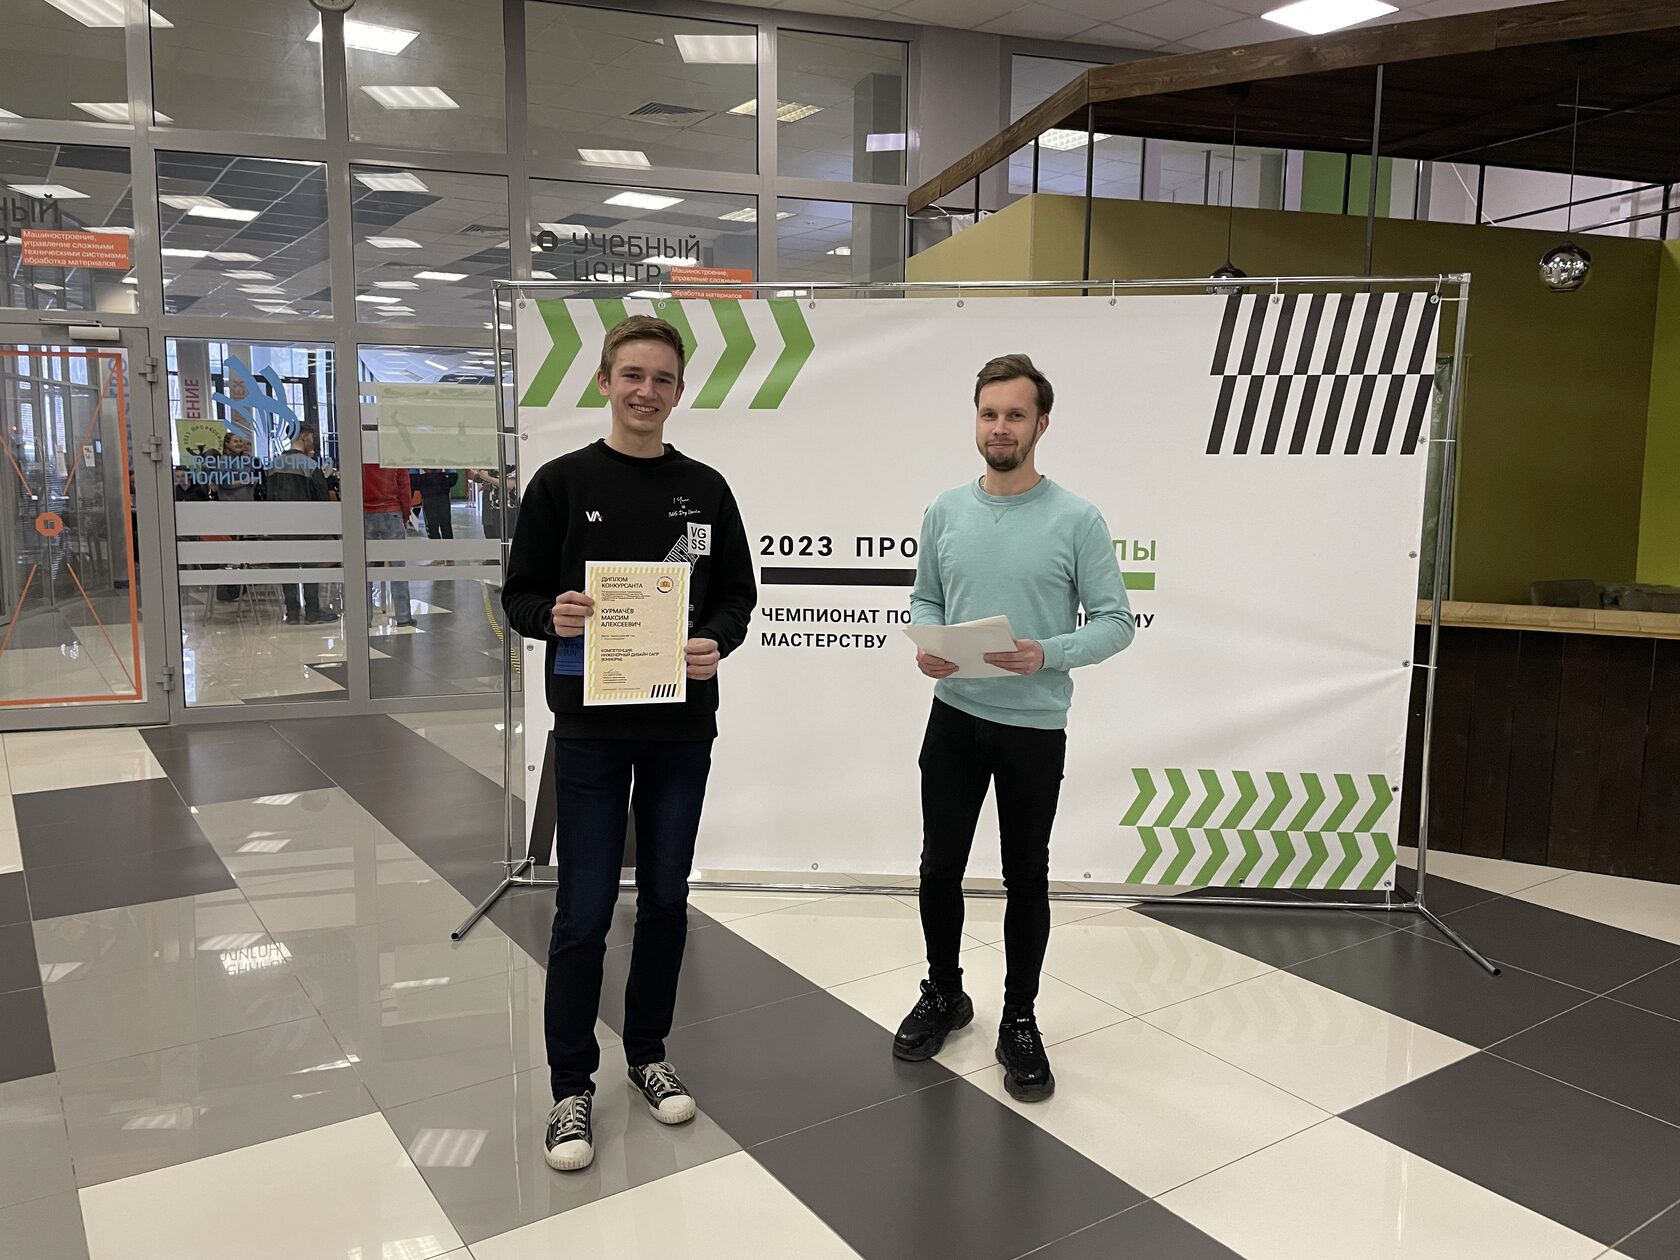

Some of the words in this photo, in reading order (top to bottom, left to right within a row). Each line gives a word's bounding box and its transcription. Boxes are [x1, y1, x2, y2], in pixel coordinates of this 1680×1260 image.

[23, 230, 97, 241] Машиностроение,
[23, 240, 71, 249] управление
[72, 241, 115, 250] сложными
[24, 249, 81, 257] техническими
[82, 251, 129, 260] системами,
[24, 256, 67, 266] обработка
[67, 259, 116, 267] материалов
[671, 267, 729, 277] Машиностроение,
[671, 289, 705, 297] обработка
[185, 470, 262, 485] ПОЛИГОН
[691, 526, 707, 538] VG
[691, 539, 706, 550] SS
[760, 535, 833, 556] 2023
[856, 537, 918, 558] ПРО
[761, 608, 880, 624] ЧЕМПИОНАТ
[886, 610, 911, 624] ПО
[761, 632, 887, 648] МАСТЕРСТВУ
